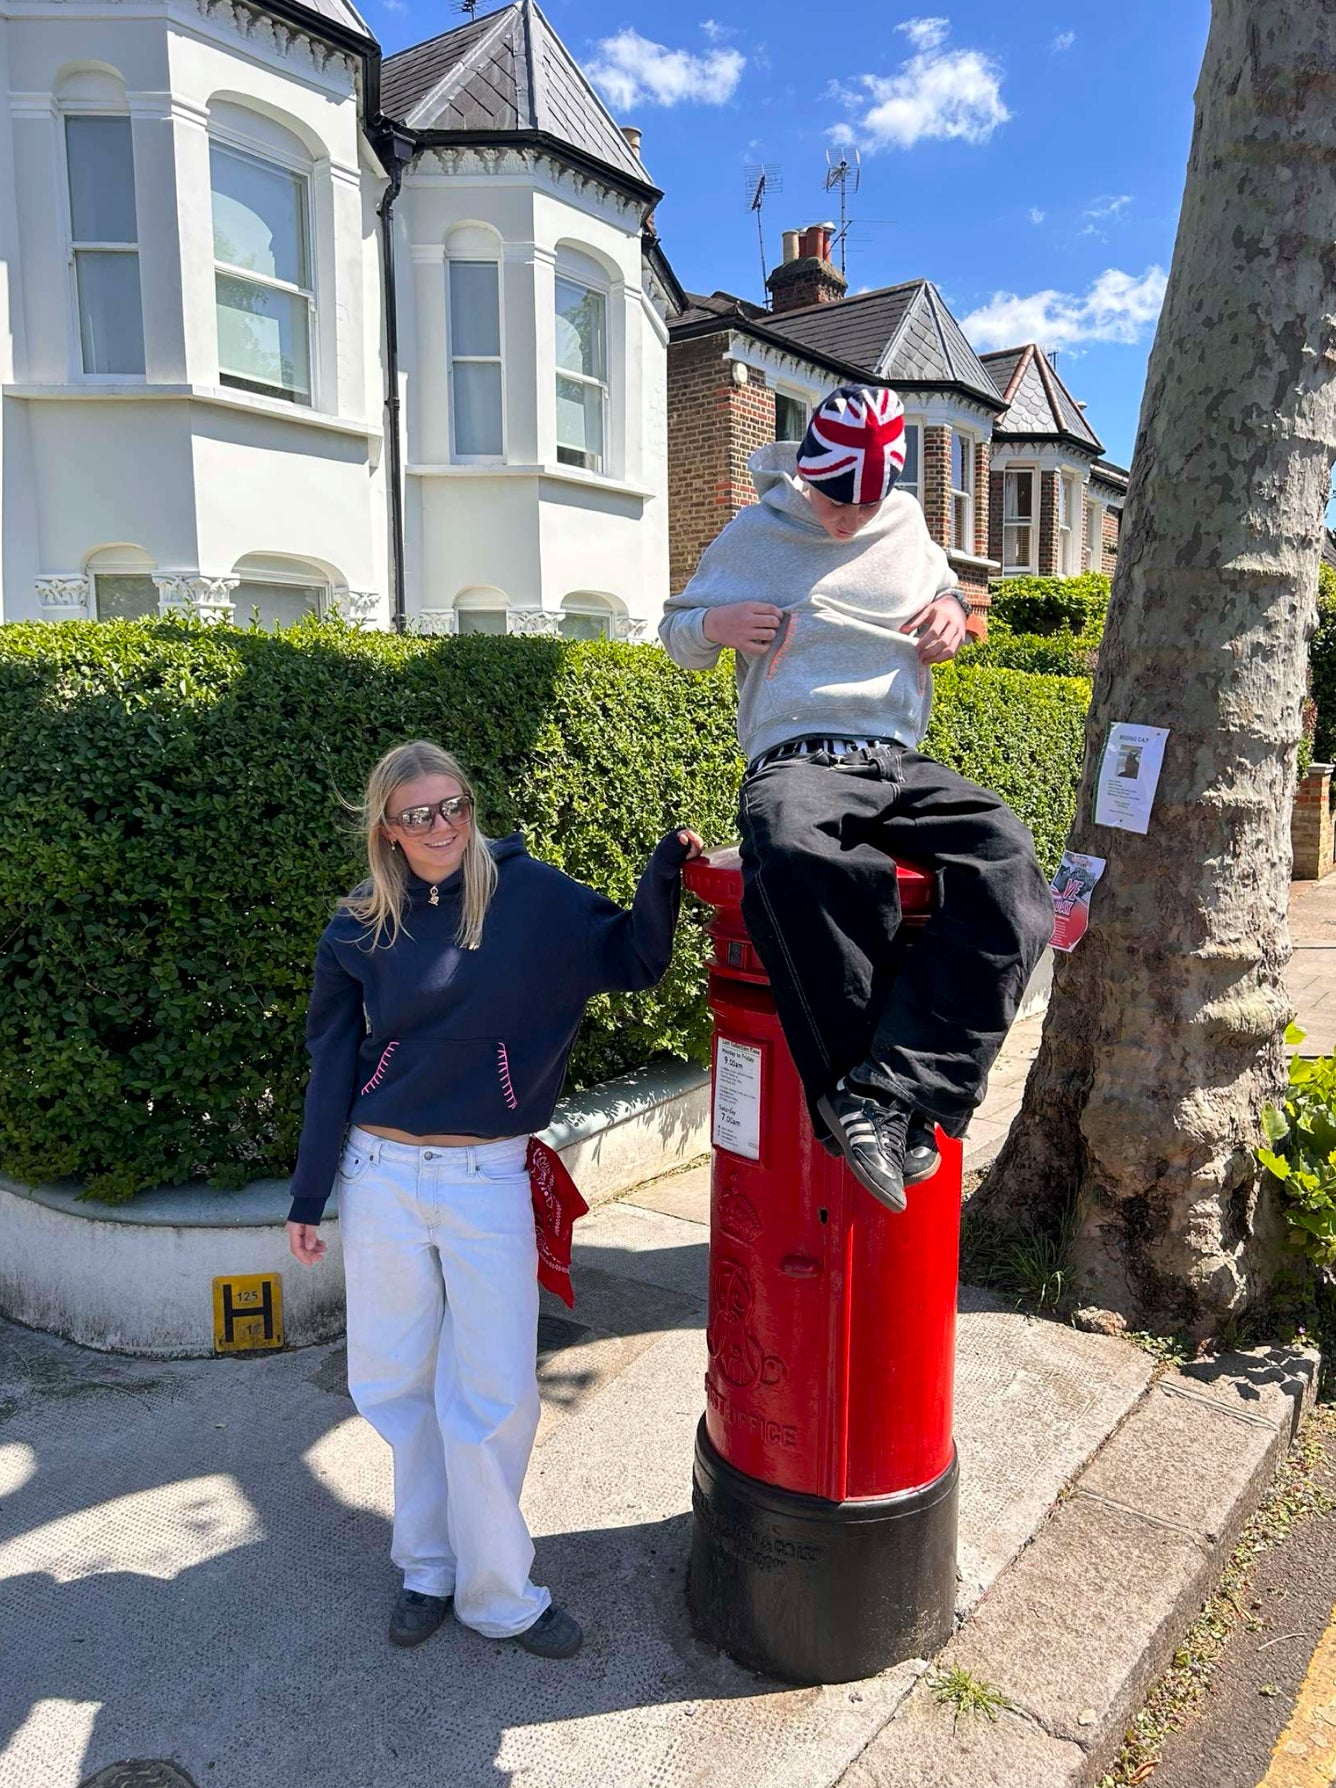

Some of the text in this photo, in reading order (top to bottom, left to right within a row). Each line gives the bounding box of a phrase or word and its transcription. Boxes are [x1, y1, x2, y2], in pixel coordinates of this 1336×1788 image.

[1062, 878, 1084, 901] VE
[1054, 900, 1074, 916] DAY
[724, 1056, 743, 1068] 9.00am
[742, 1053, 754, 1063] Friday
[721, 1112, 741, 1126] 7.00am
[237, 1291, 258, 1302] 125
[223, 1281, 273, 1343] H
